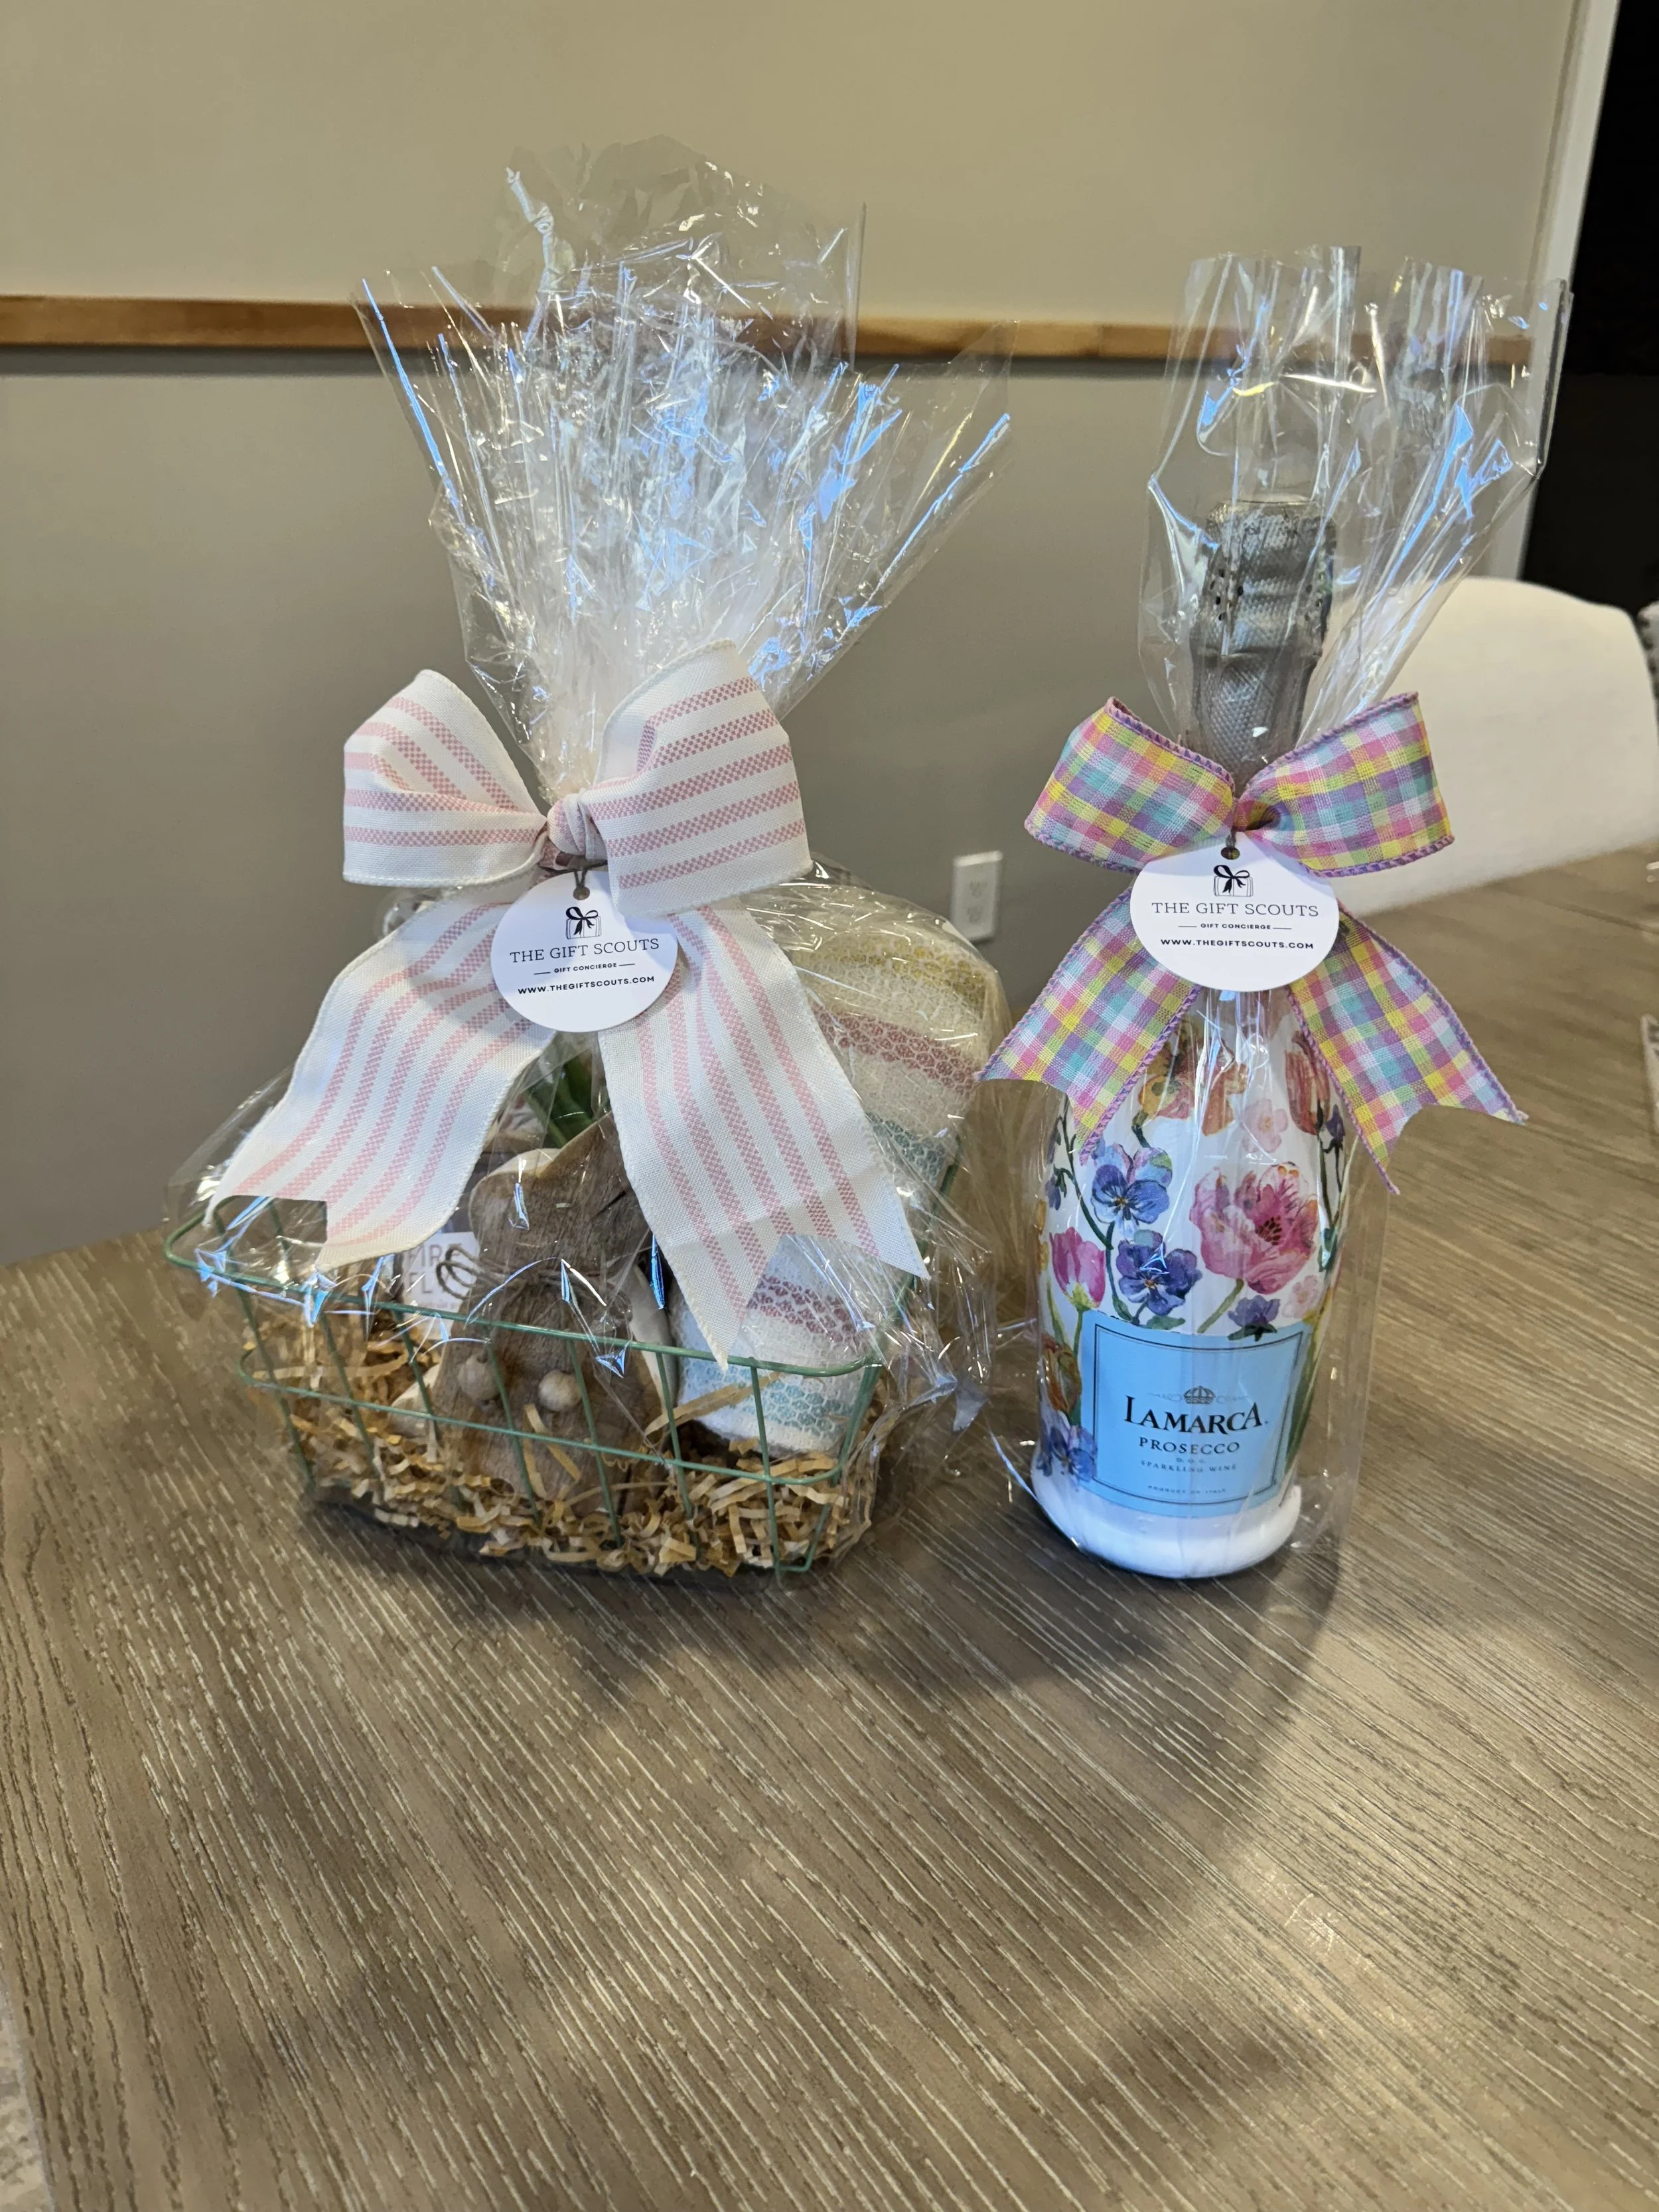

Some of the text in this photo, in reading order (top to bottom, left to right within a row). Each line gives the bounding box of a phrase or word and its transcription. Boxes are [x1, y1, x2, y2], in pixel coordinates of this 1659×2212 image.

[1151, 903, 1319, 917] THE GIFT SCOUTS
[510, 938, 660, 963] THE GIFT SCOUTS
[1161, 939, 1314, 949] WWW.THEGIFTSCOUTS.COM
[573, 962, 617, 972] CONCIERGE
[518, 976, 655, 994] WWW.THEGIFTSCOUTS.COM
[1139, 1436, 1240, 1455] PROSECCO
[1141, 1459, 1238, 1473] SPARKLING WINE
